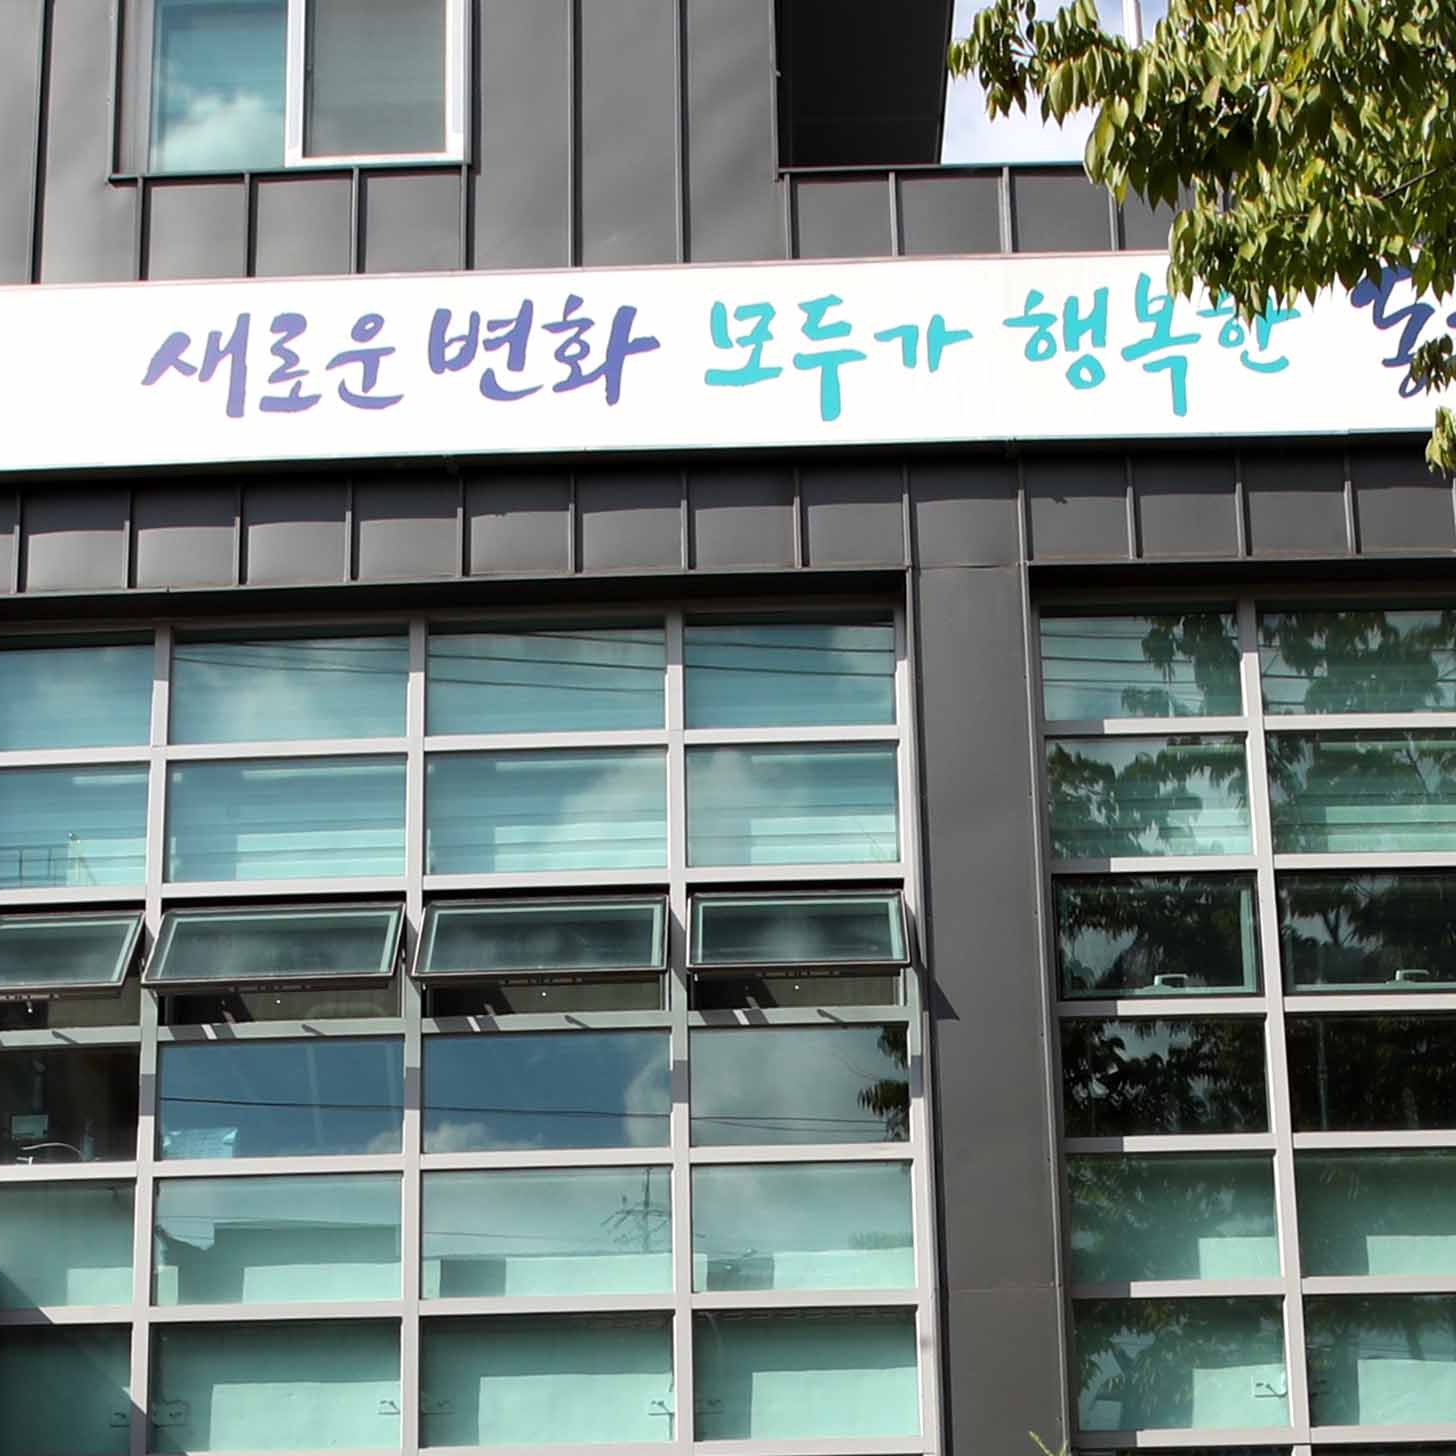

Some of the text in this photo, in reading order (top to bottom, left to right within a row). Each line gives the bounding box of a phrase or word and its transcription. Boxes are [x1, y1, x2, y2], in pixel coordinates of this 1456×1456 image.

[141, 313, 403, 417] 새로운
[428, 293, 661, 406] 변화
[705, 294, 973, 421] 모두가
[1002, 271, 1302, 417] 행복한
